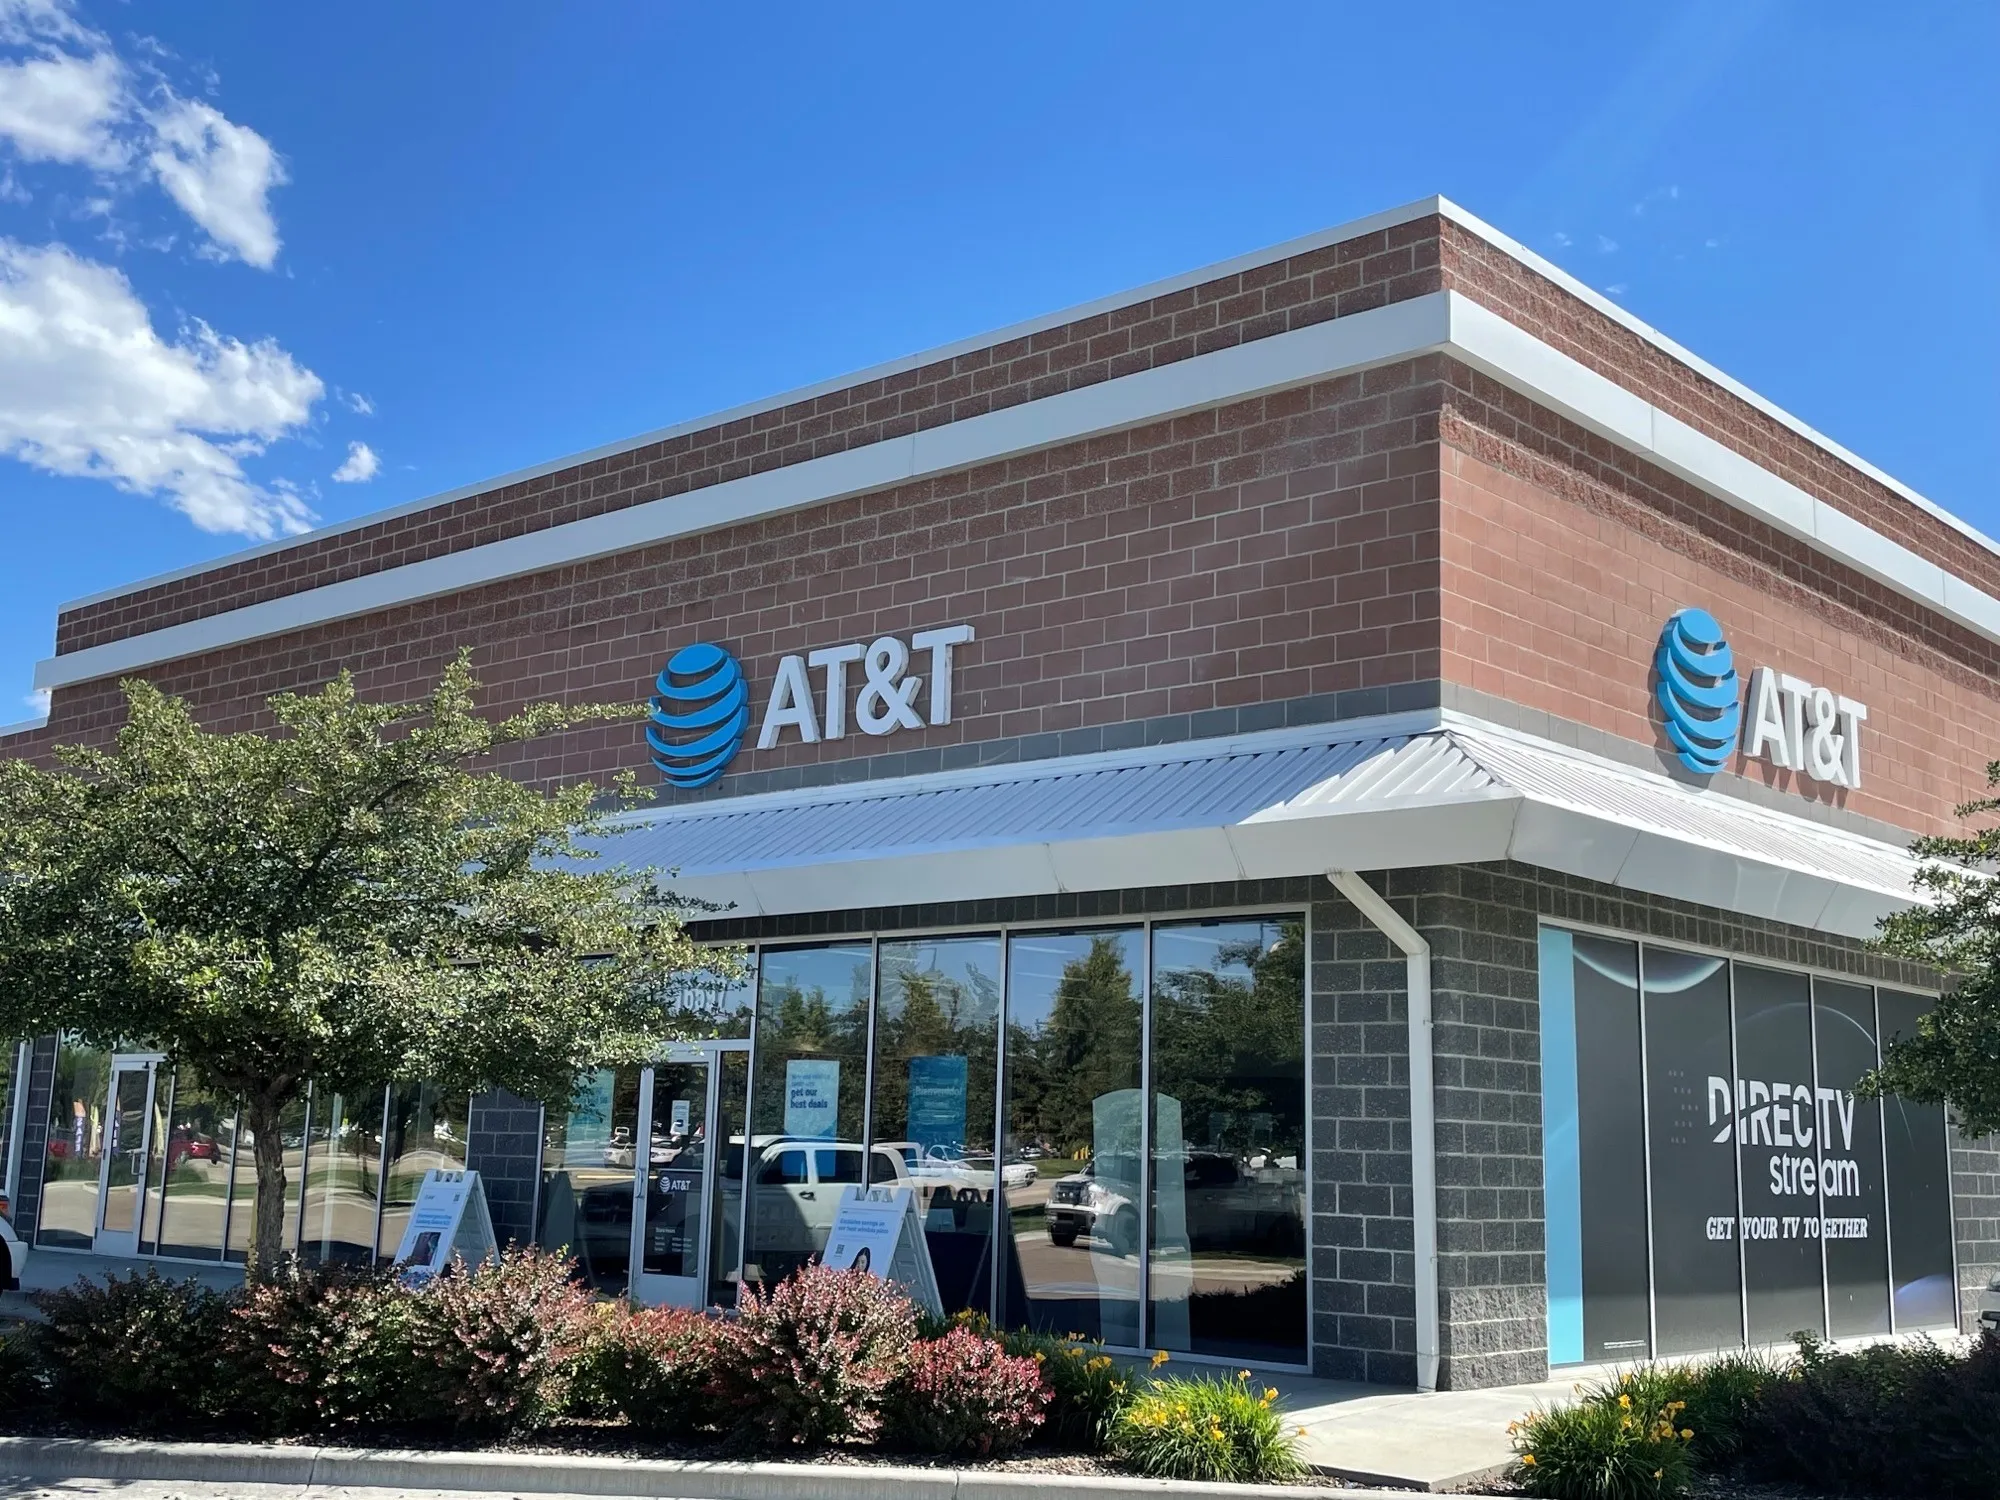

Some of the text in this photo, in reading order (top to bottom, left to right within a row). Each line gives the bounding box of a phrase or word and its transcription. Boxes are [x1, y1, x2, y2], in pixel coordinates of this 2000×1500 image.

[757, 624, 975, 750] AT&T
[1743, 666, 1867, 789] AT&T
[790, 1099, 828, 1109] best deals
[791, 1089, 818, 1099] get our
[1707, 1076, 1855, 1151] DIRECTV
[671, 1180, 691, 1191] AT&T
[1769, 1153, 1860, 1197] stream
[1706, 1216, 1735, 1240] GET
[1742, 1217, 1778, 1240] YOUR
[1782, 1217, 1801, 1239] TV
